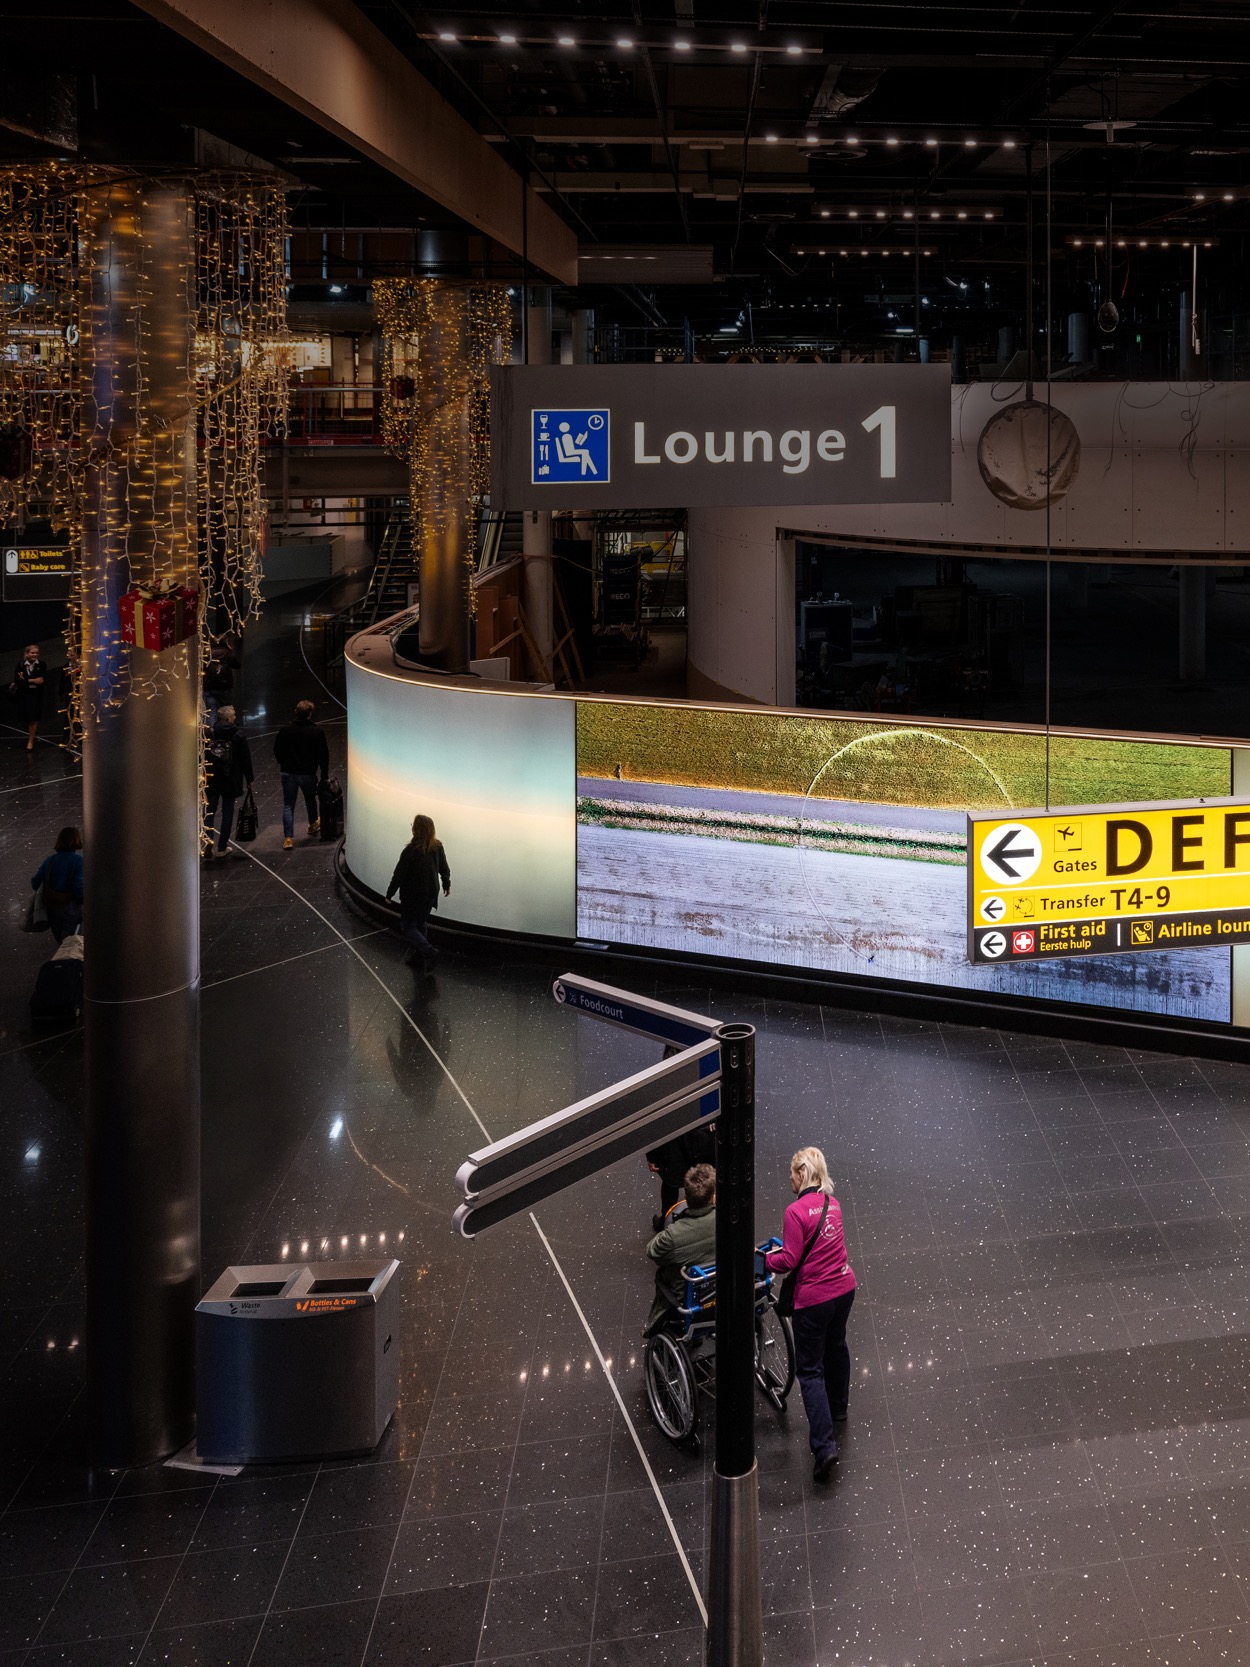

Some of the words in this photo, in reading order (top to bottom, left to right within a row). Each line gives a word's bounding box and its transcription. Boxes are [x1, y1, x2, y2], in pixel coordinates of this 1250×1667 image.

[634, 421, 847, 475] Lounge
[860, 405, 897, 479] 1
[30, 563, 49, 571] Baby
[1053, 858, 1098, 874] Gates
[1040, 893, 1106, 911] Transfer
[1110, 885, 1171, 911] T4-9
[1040, 923, 1076, 939] First
[1080, 921, 1106, 937] aid
[1158, 920, 1212, 938] Airline
[1040, 940, 1065, 951] Eerste
[1067, 938, 1092, 951] hulp
[579, 995, 624, 1019] Foodcourt
[310, 1299, 333, 1307] Bottles
